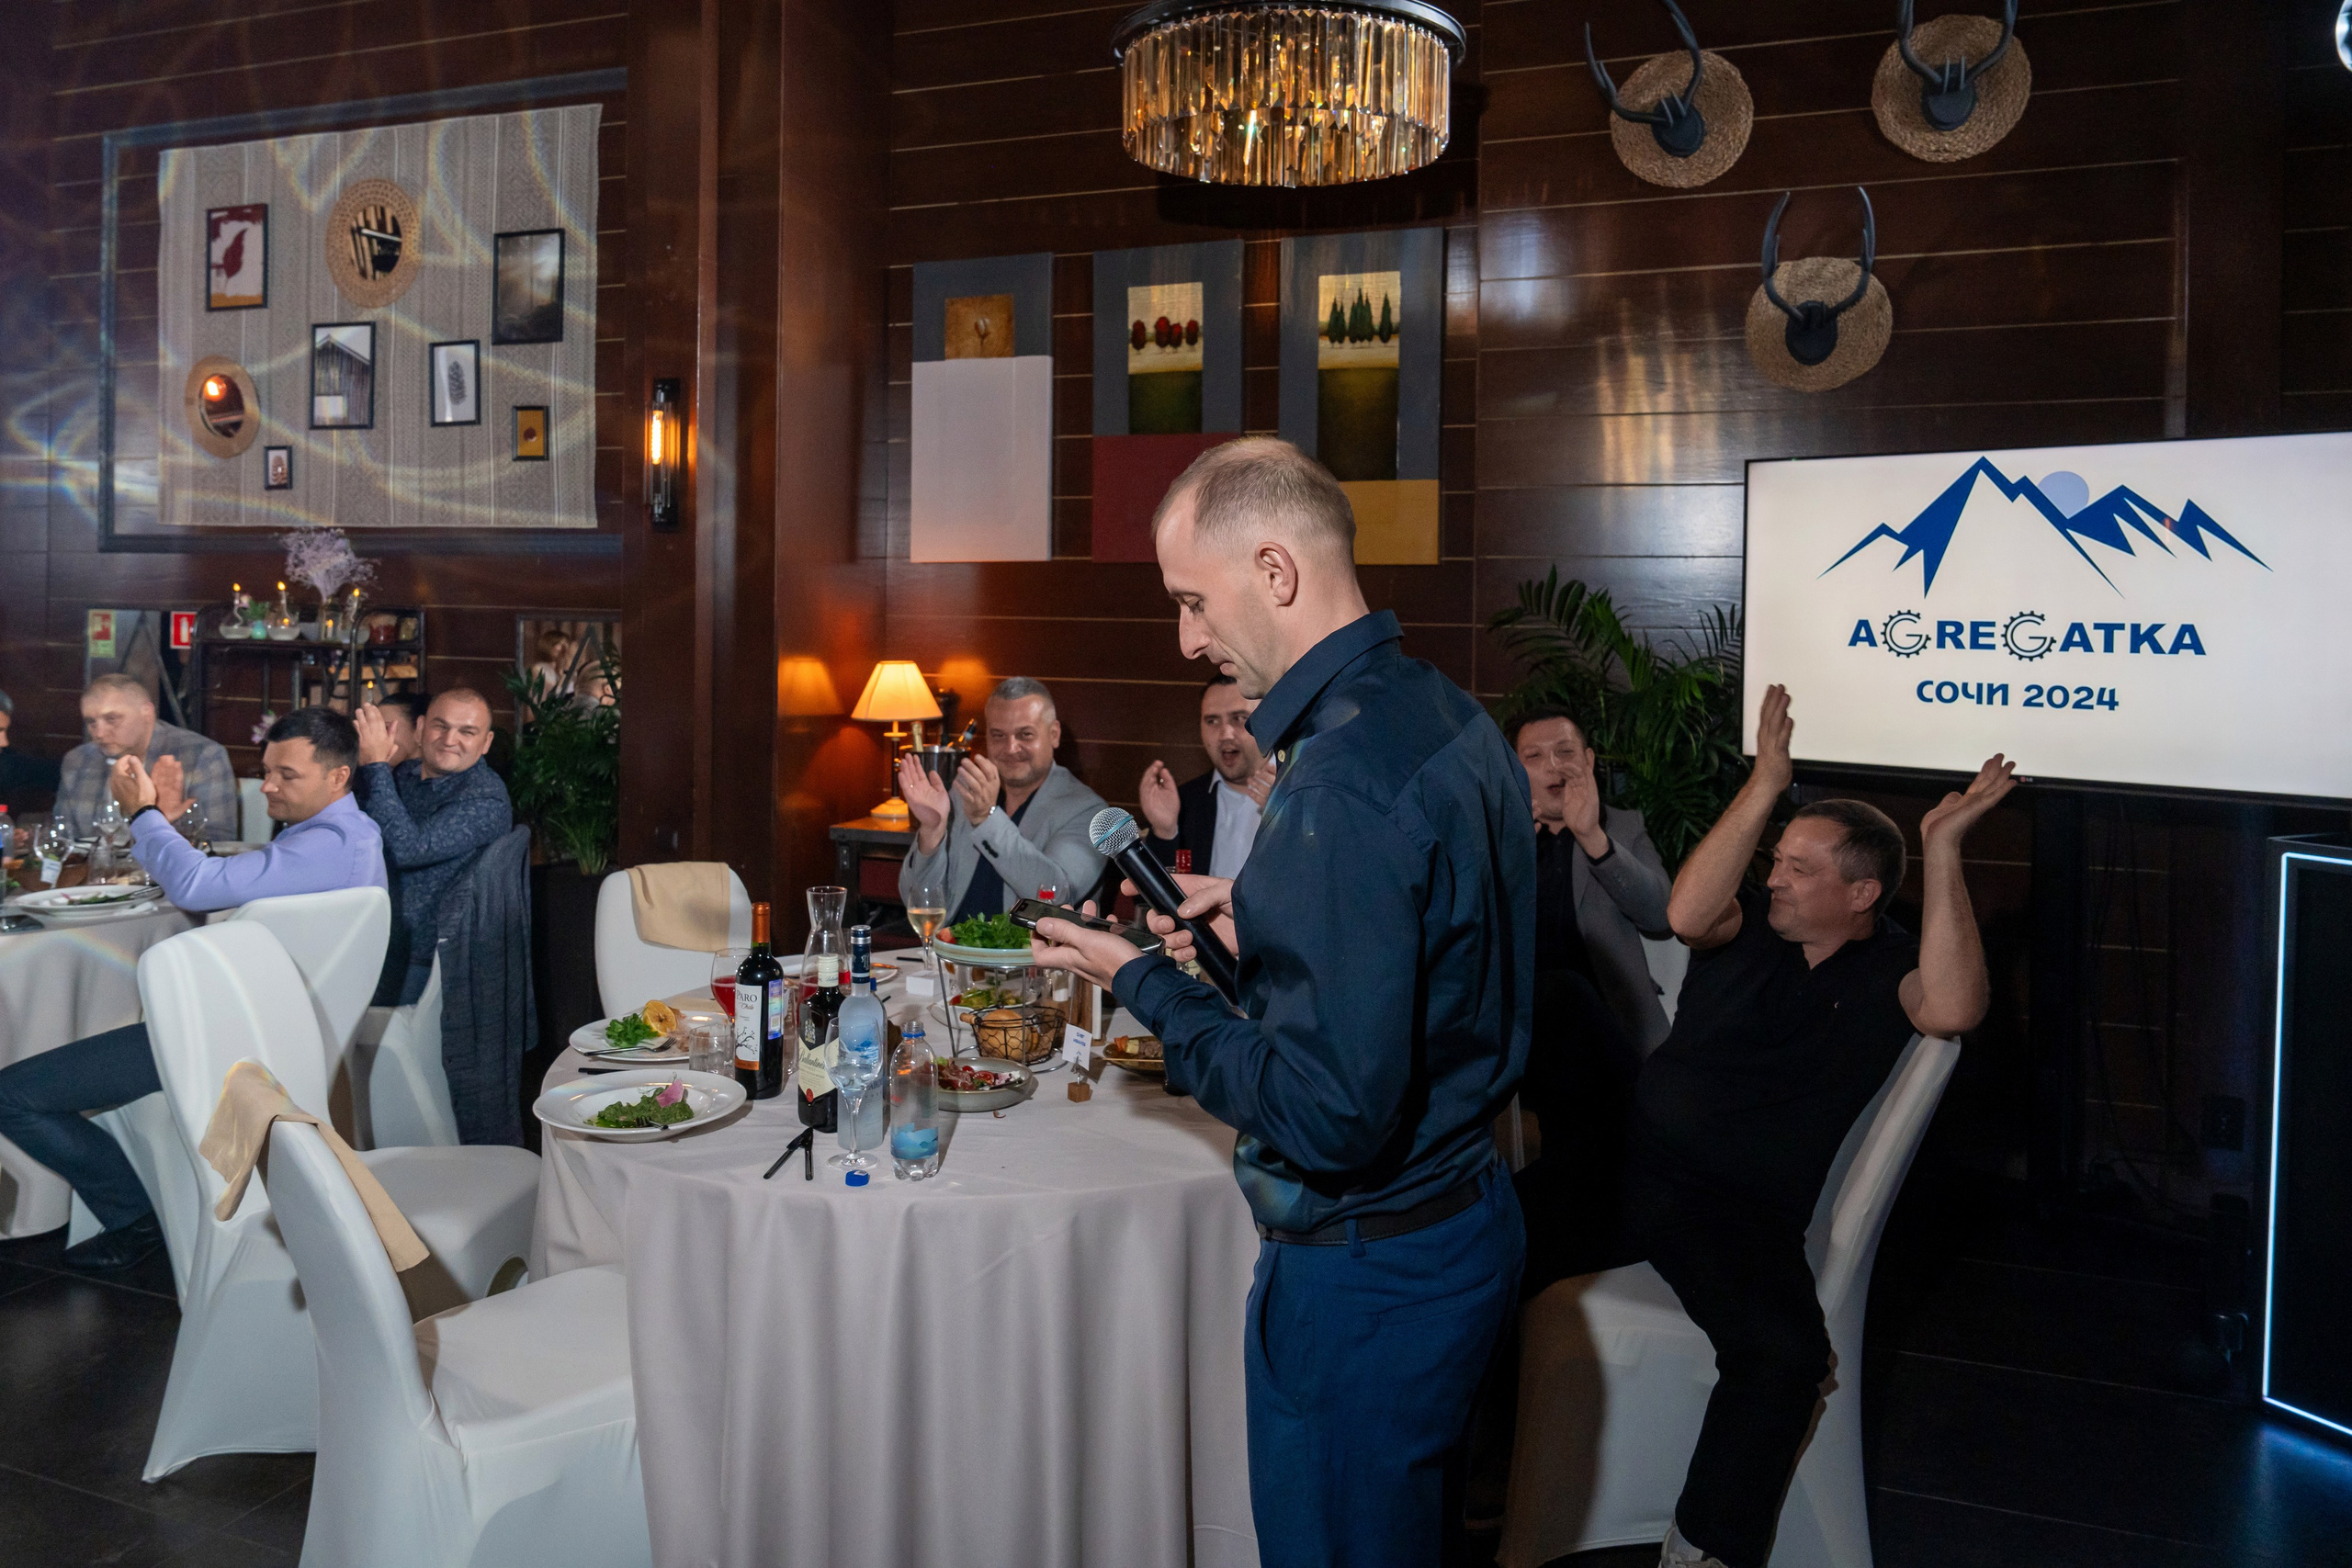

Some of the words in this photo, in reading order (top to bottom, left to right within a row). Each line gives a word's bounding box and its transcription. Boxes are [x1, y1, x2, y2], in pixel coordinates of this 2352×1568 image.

[1848, 609, 2207, 662] AGREGATKA
[1916, 680, 2009, 706] СОЧИ
[2022, 683, 2120, 711] 2024
